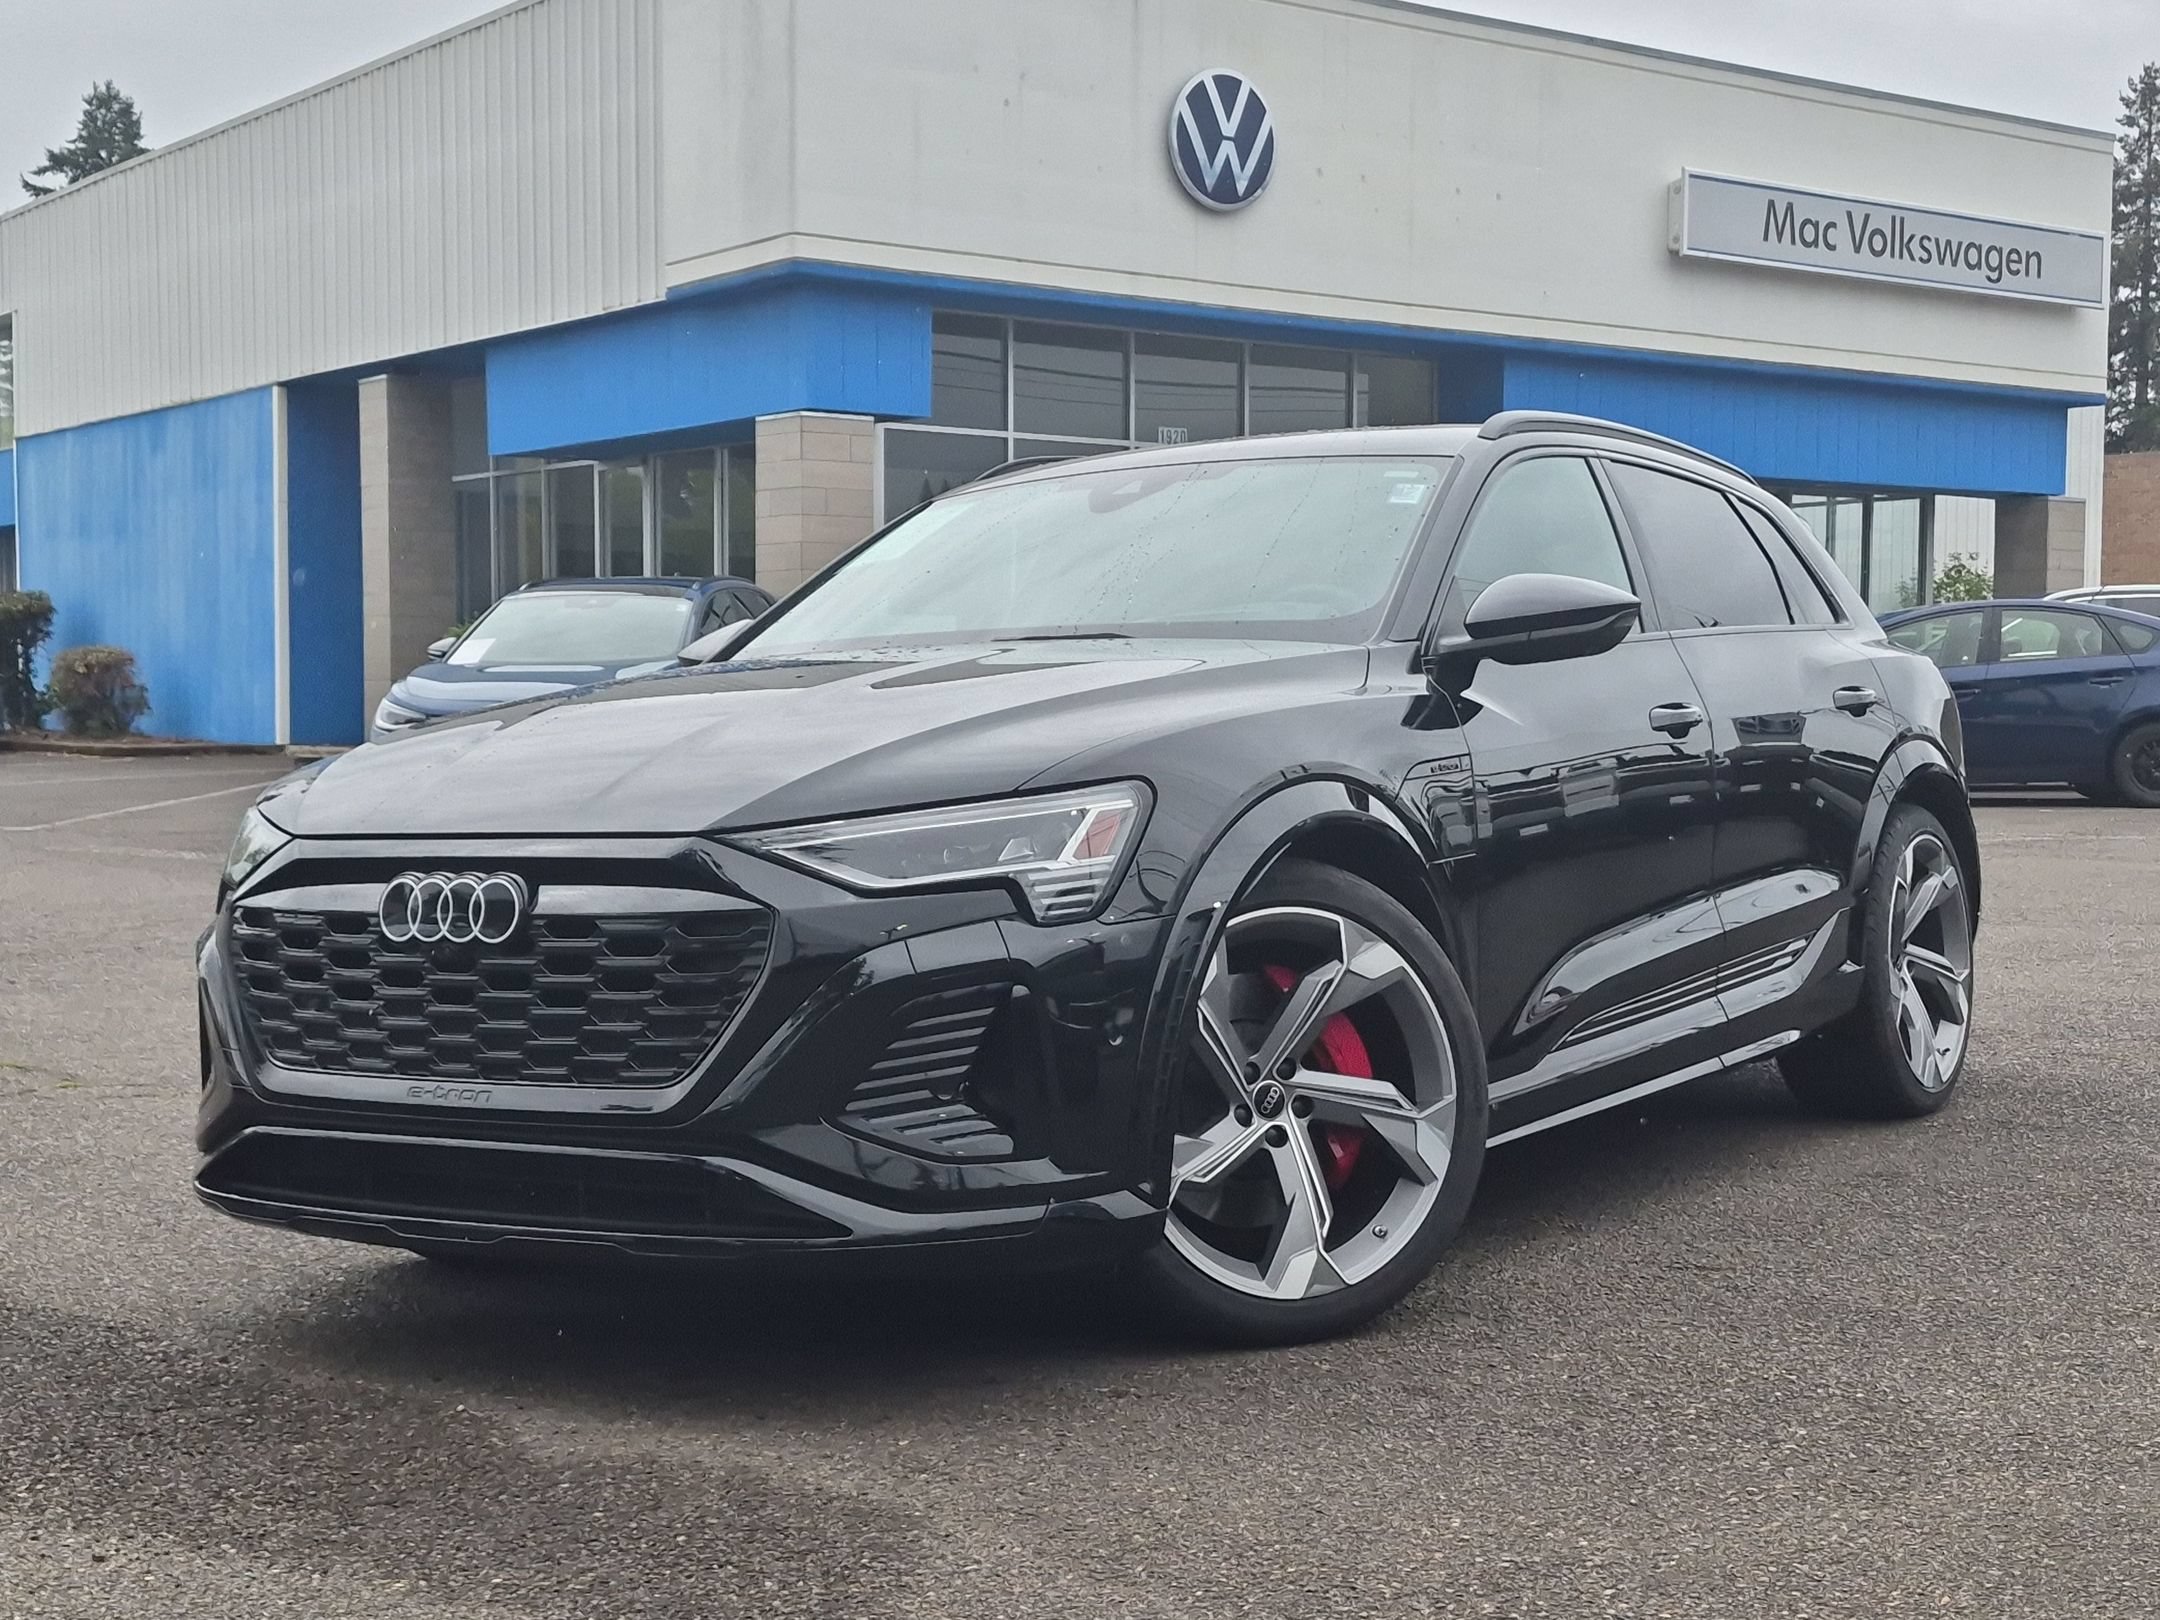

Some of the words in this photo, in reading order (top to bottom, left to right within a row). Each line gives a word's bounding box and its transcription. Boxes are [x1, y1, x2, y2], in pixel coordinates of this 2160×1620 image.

[1176, 72, 1274, 199] VW
[1762, 198, 1837, 252] Mac
[1845, 209, 2043, 284] Volkswagen
[1159, 429, 1186, 445] 1920
[406, 1084, 493, 1103] e-tron
